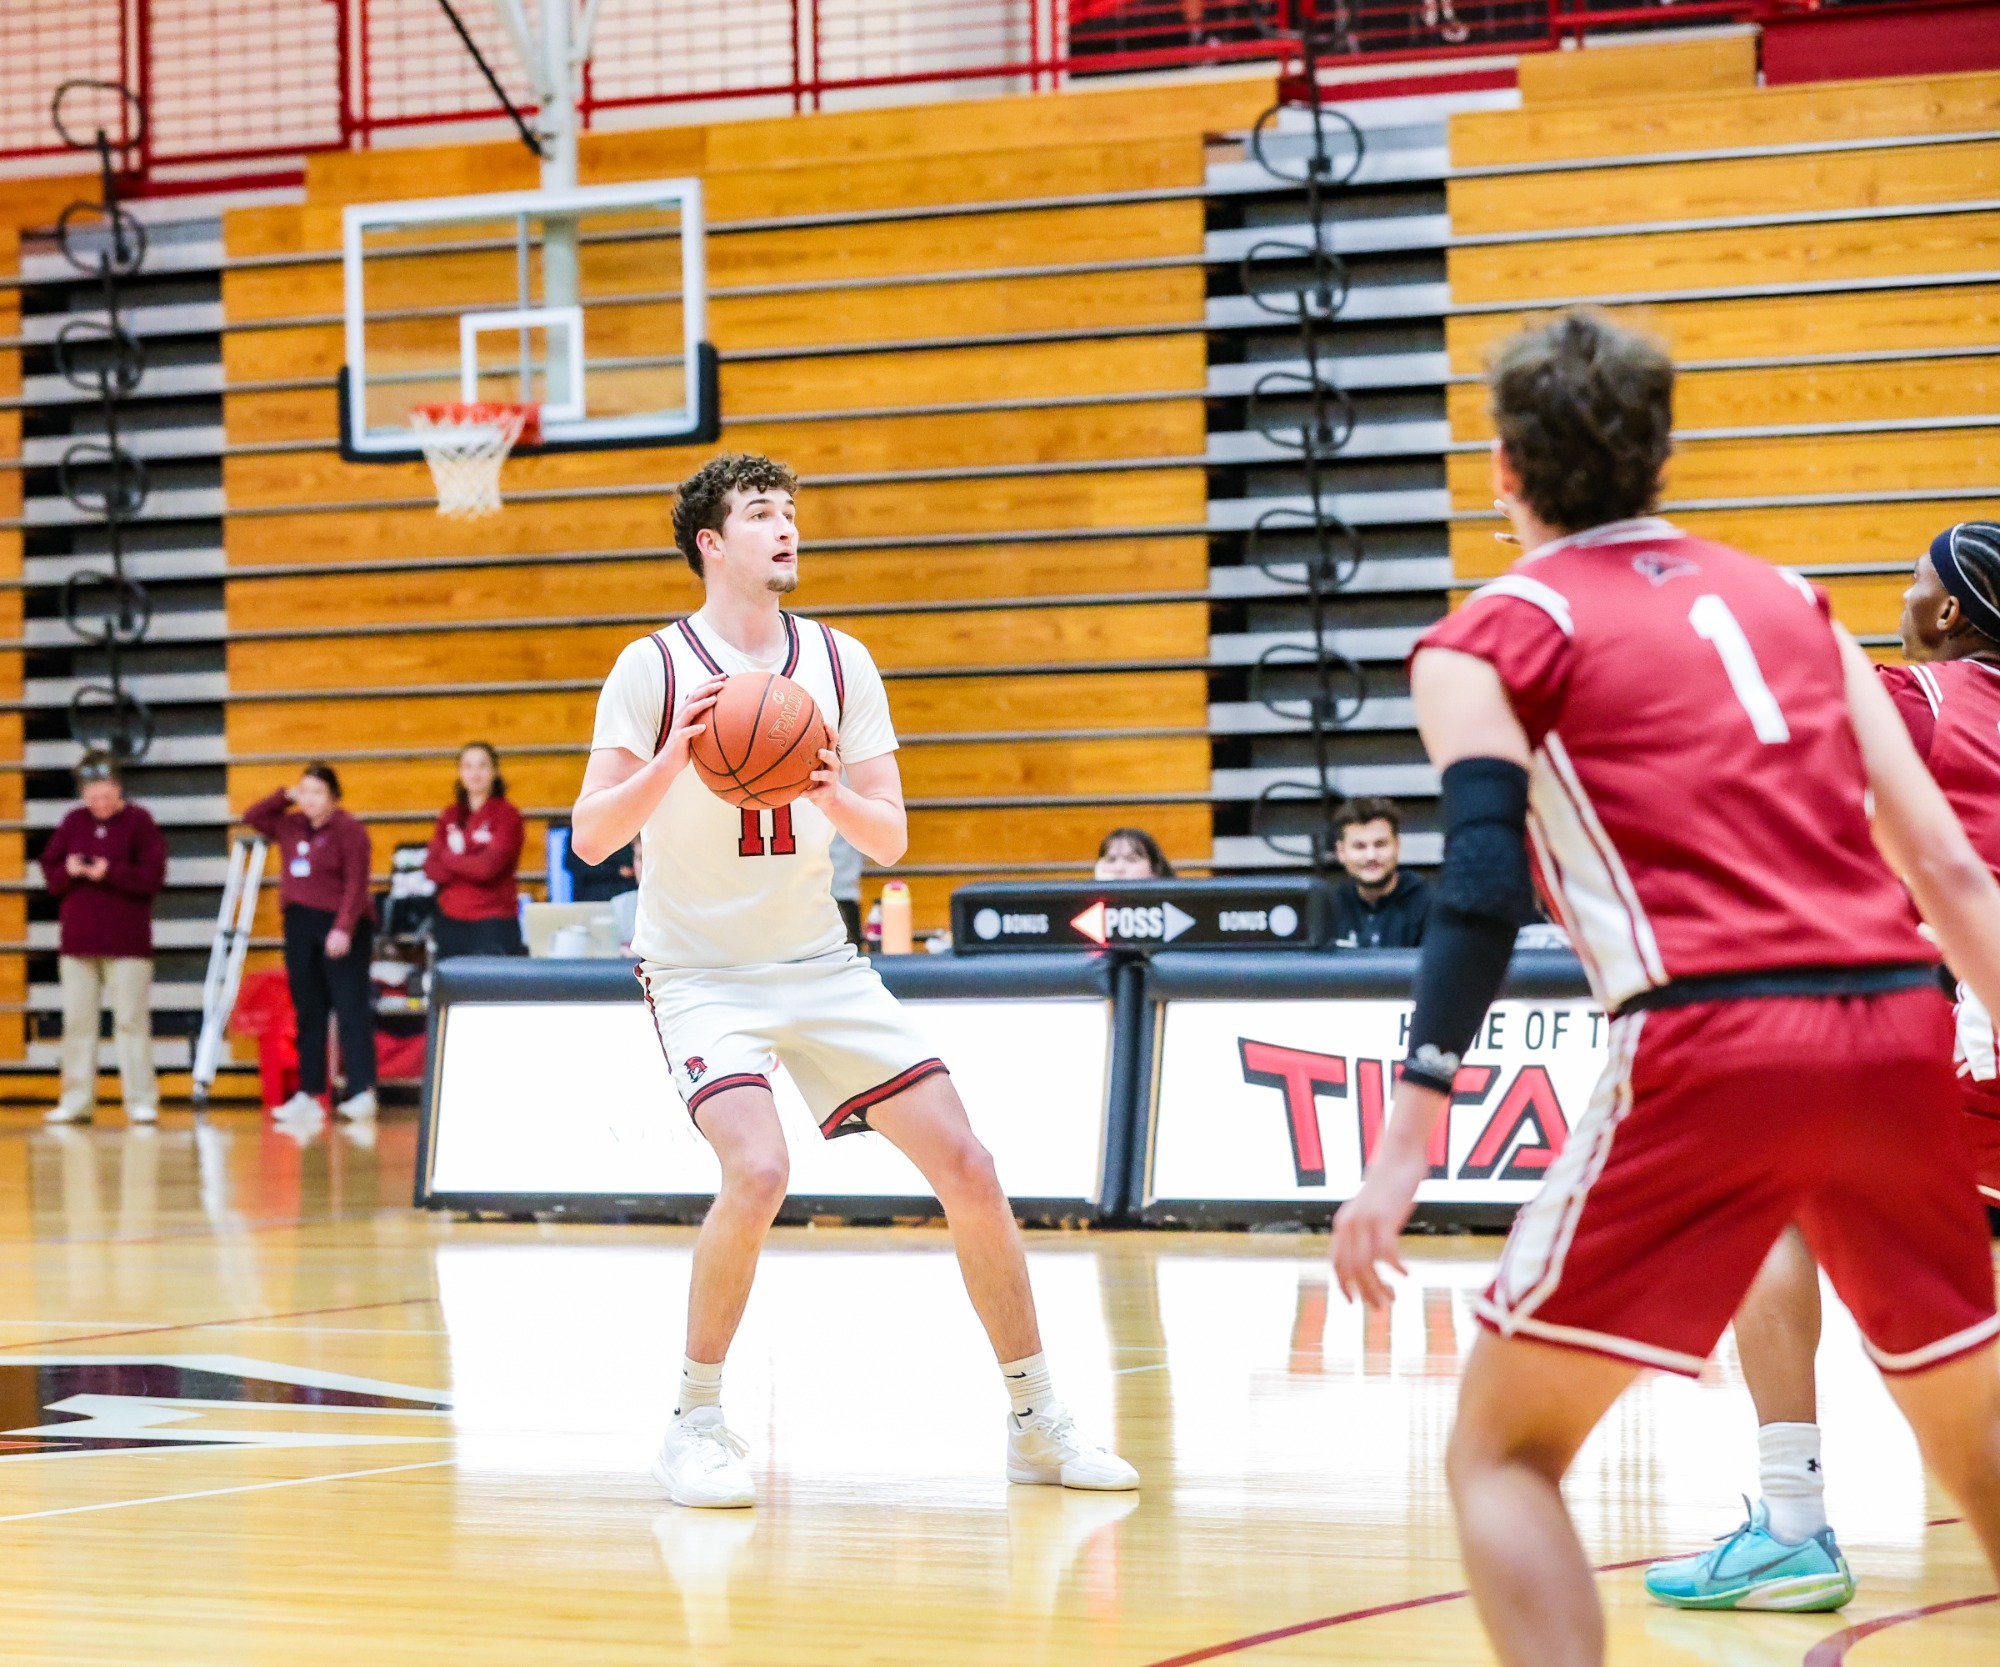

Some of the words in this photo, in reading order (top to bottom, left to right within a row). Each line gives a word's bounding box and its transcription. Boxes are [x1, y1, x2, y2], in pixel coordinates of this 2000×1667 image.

[1688, 594, 1791, 744] 1
[768, 685, 807, 749] SPALD
[736, 803, 796, 857] 11
[1002, 913, 1050, 934] BONUS
[1104, 906, 1163, 938] POSS
[1218, 910, 1268, 931] BONUS
[1399, 1012, 1506, 1050] HE
[1525, 1009, 1570, 1050] OF
[1587, 1011, 1606, 1049] T
[1238, 1036, 1569, 1187] TITA
